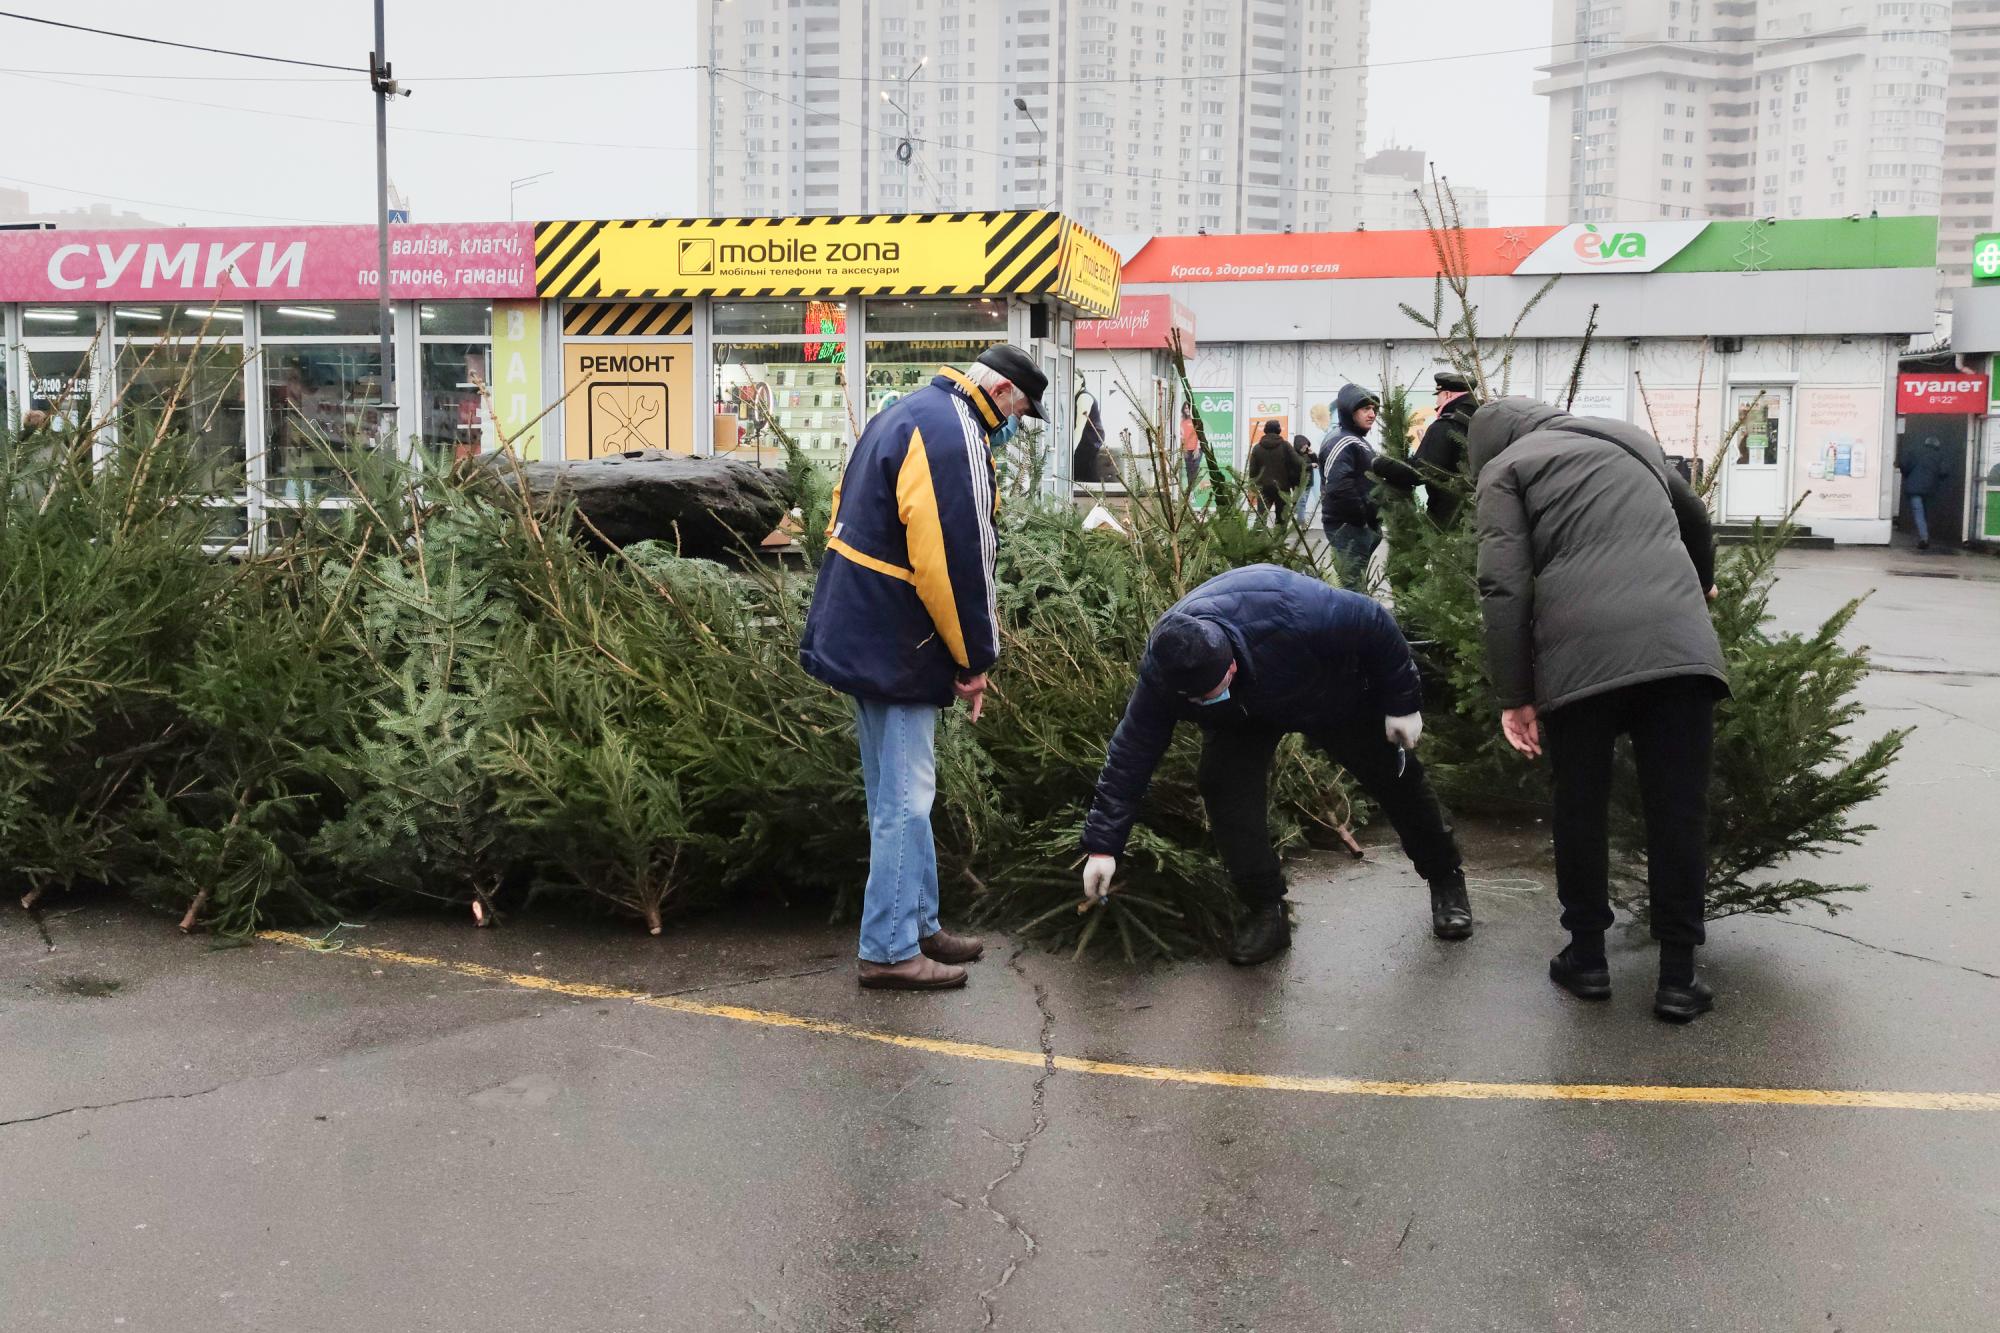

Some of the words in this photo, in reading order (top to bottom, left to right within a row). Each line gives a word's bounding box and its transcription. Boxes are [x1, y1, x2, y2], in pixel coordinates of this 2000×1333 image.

[392, 234, 453, 257] валізи,
[460, 231, 523, 256] клатчі,
[719, 238, 817, 264] mobile
[826, 241, 900, 262] zona
[47, 241, 307, 290] СУМКИ
[358, 269, 448, 288] потмоне,
[454, 264, 525, 287] гаманці
[719, 267, 767, 277] мобільні
[769, 267, 822, 278] телефони
[825, 267, 838, 276] та
[841, 267, 900, 277] аксесуари
[1171, 263, 1214, 279] Краса,
[1216, 262, 1275, 278] здоров'я
[1277, 264, 1298, 275] та
[580, 355, 675, 373] РЕМОНТ
[1903, 380, 1982, 396] туалет
